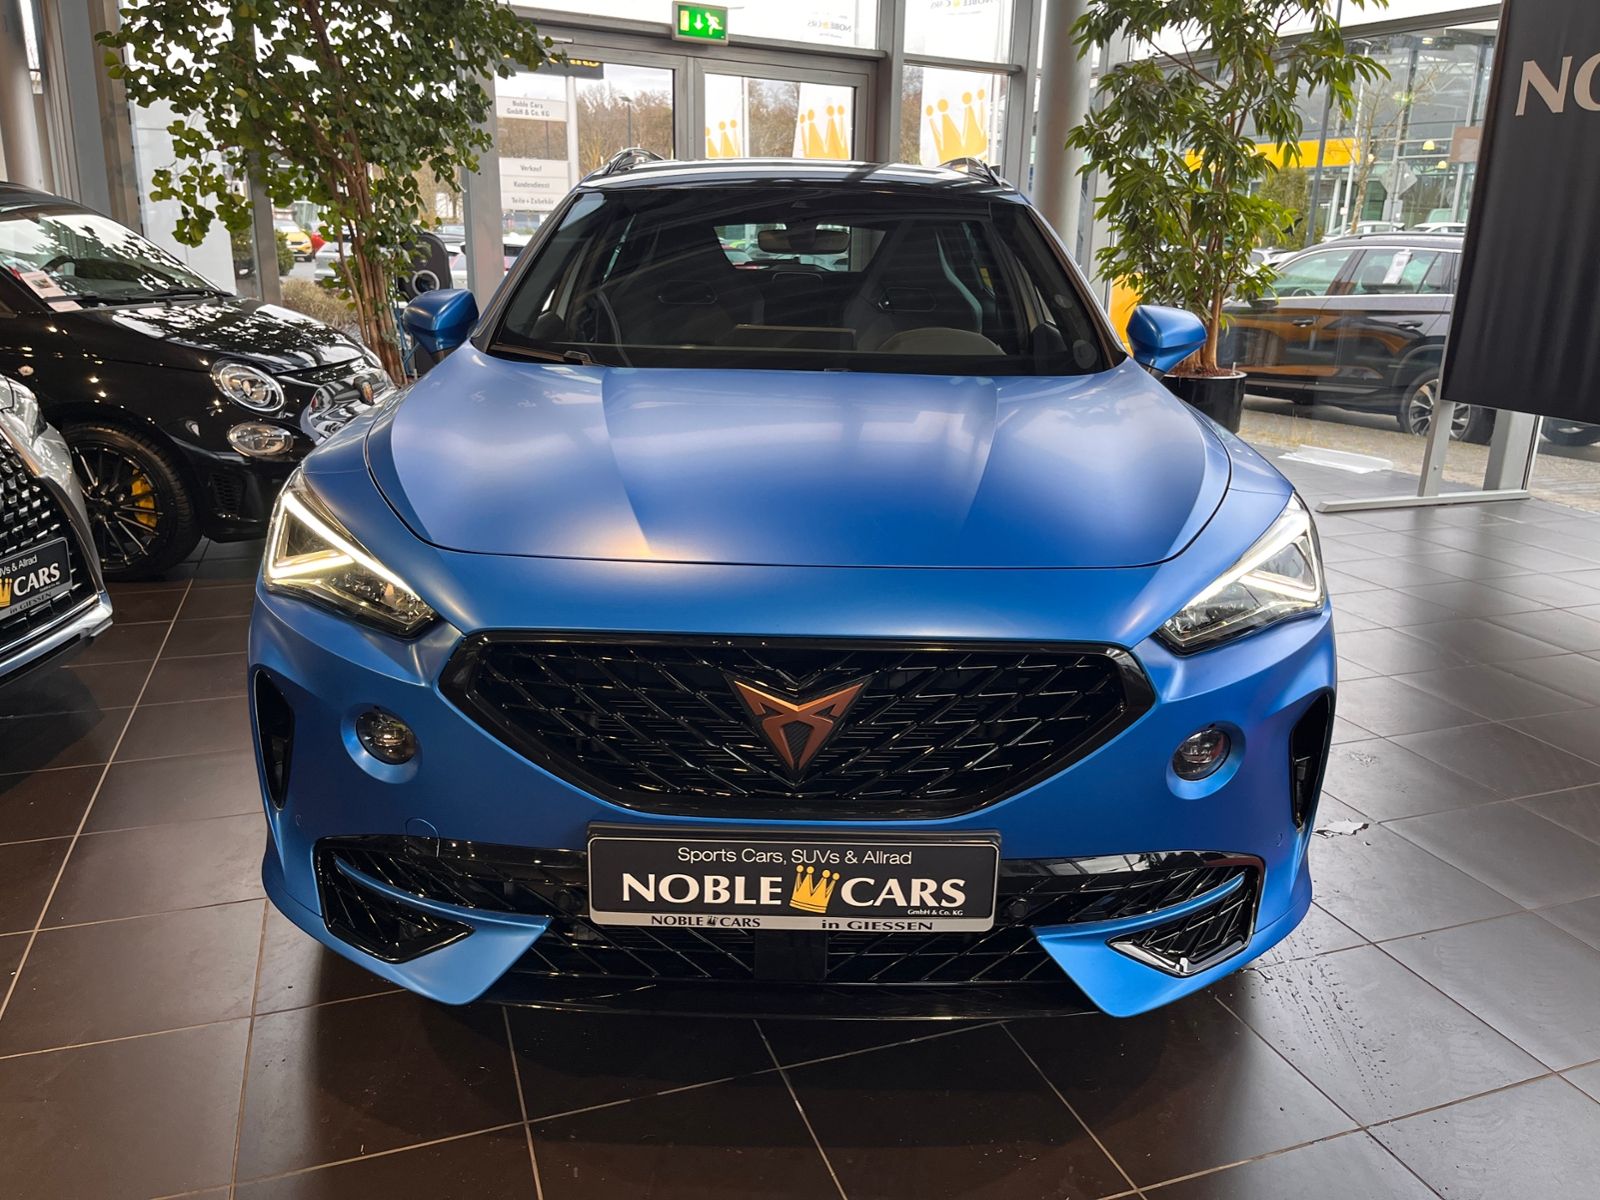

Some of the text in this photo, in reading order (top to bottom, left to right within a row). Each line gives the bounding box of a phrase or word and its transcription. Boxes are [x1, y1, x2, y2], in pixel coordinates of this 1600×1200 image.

[530, 101, 543, 109] Cars
[520, 164, 542, 172] Verkauf
[11, 562, 18, 572] &
[18, 554, 38, 569] Allrad
[13, 562, 60, 596] CARS
[677, 846, 912, 865] Sports Cars, SUVs & Allrad
[622, 872, 967, 908] NOBLE CARS
[651, 915, 761, 928] NOBLE CARS
[821, 920, 934, 931] in GIESSEN
